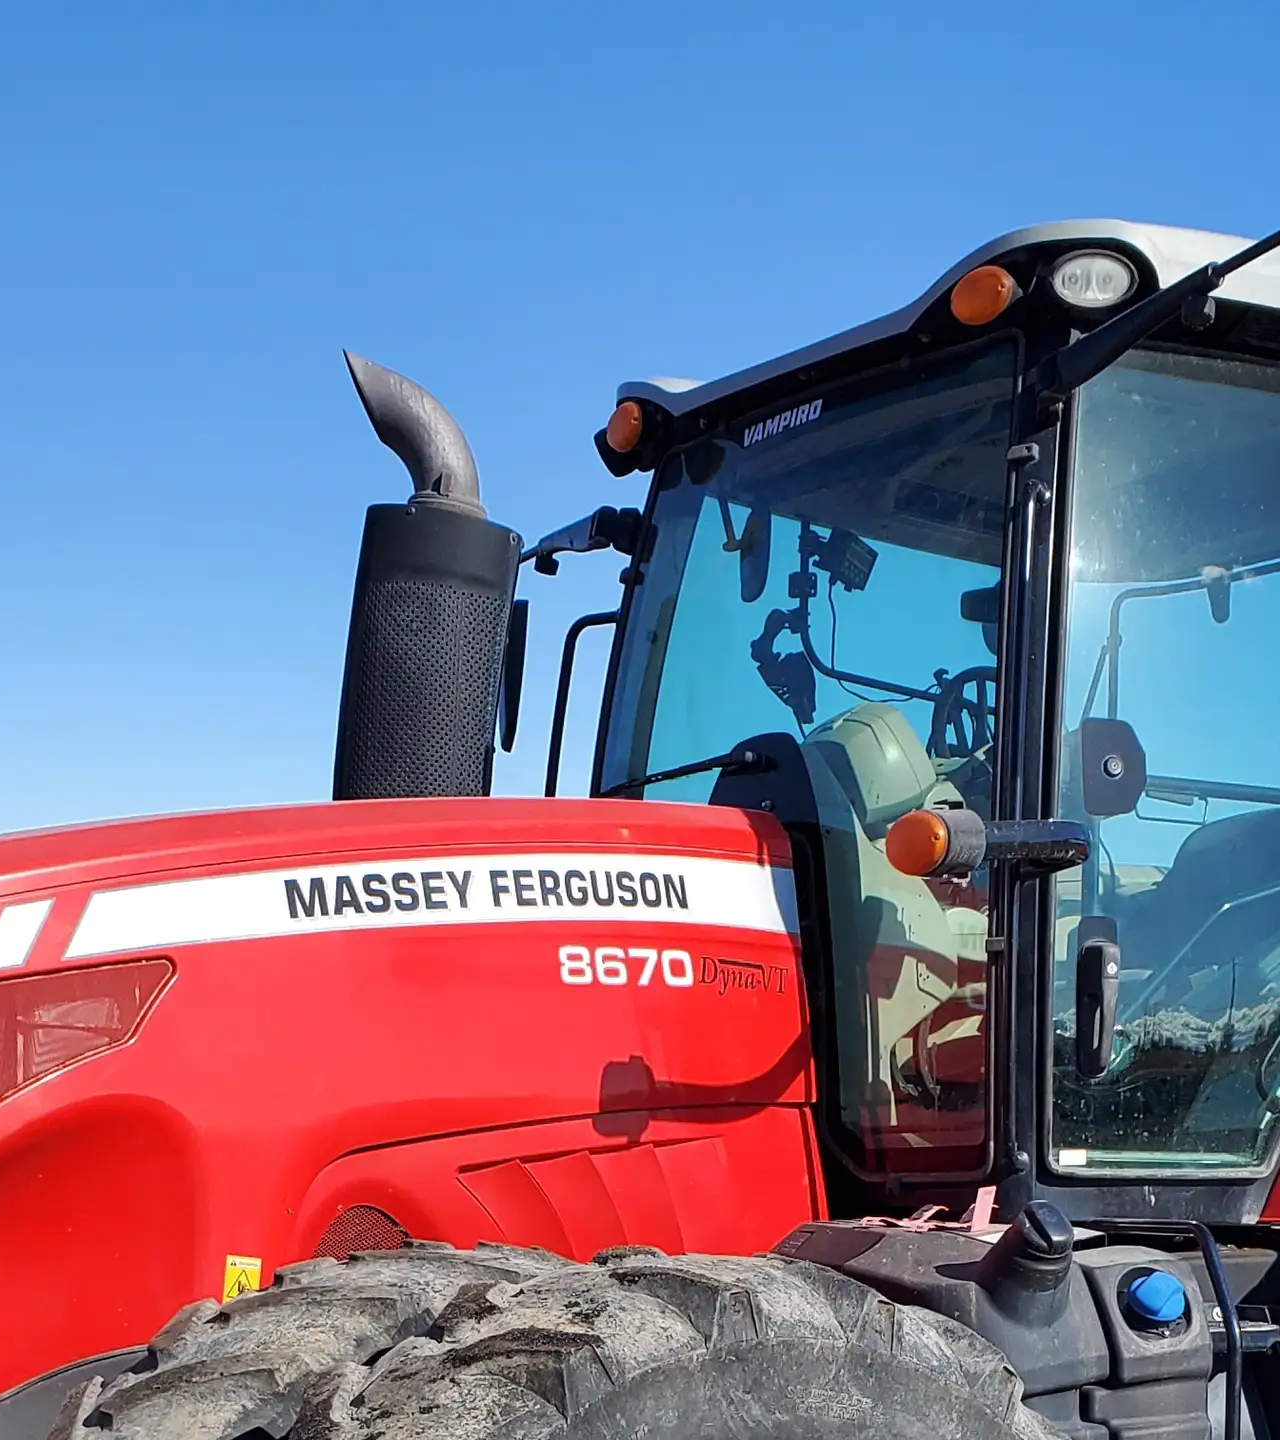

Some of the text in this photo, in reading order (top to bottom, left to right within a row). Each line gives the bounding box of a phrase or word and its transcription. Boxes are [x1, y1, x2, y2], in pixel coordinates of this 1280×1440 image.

[743, 398, 823, 448] VAMPIRO
[283, 869, 689, 919] MASSEY FERGUSON
[559, 944, 789, 995] 8670 Dyna-VT
